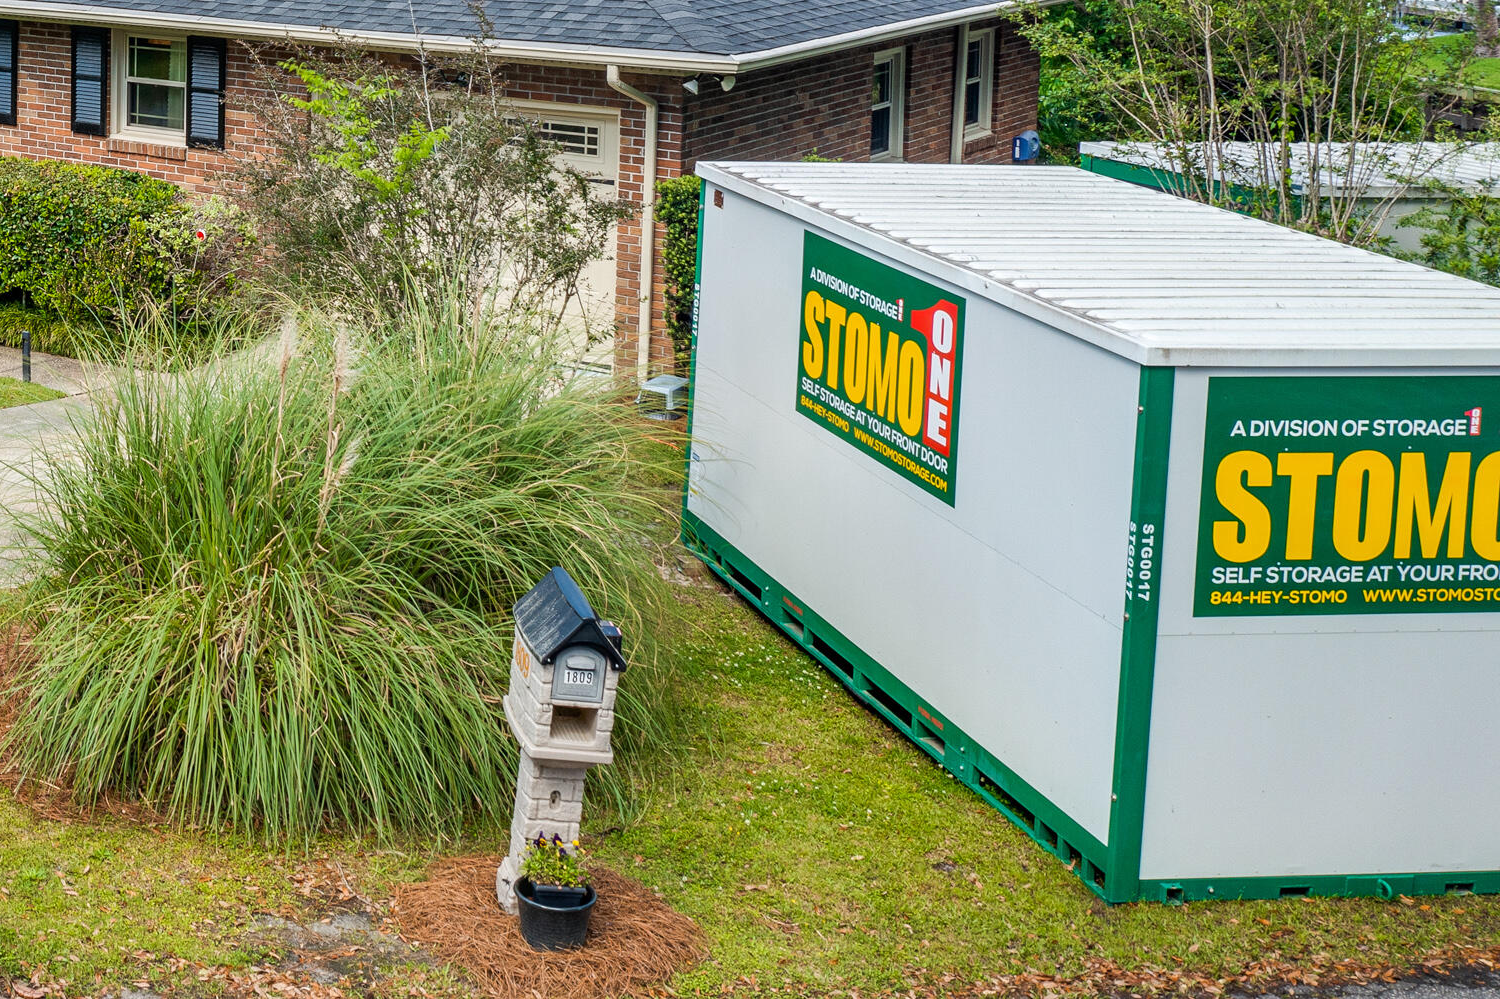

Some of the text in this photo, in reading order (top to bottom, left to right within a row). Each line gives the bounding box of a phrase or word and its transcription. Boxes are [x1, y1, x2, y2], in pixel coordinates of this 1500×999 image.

[810, 266, 816, 280] A
[816, 269, 848, 296] DIVISION
[848, 285, 860, 300] OF
[859, 290, 898, 320] STORAGE
[802, 290, 925, 437] STOMO
[927, 309, 953, 447] ONE
[800, 394, 948, 493] 844-HEY-STOMO WWW.STOMOSTORAGE.COM
[801, 376, 948, 475] SELF STORAGE AT YOUR FRONT DOOR
[1230, 420, 1247, 437] A
[1250, 420, 1338, 437] DIVISION
[1341, 420, 1369, 437] OF
[1372, 419, 1467, 437] STORAGE
[1125, 521, 1137, 601] STG0017
[1137, 523, 1155, 602] STG0017
[1210, 590, 1348, 604] 844-HEY-STOMO
[1211, 564, 1500, 584] SELF STORAGE AT YOUR FRO
[566, 671, 593, 684] 1809
